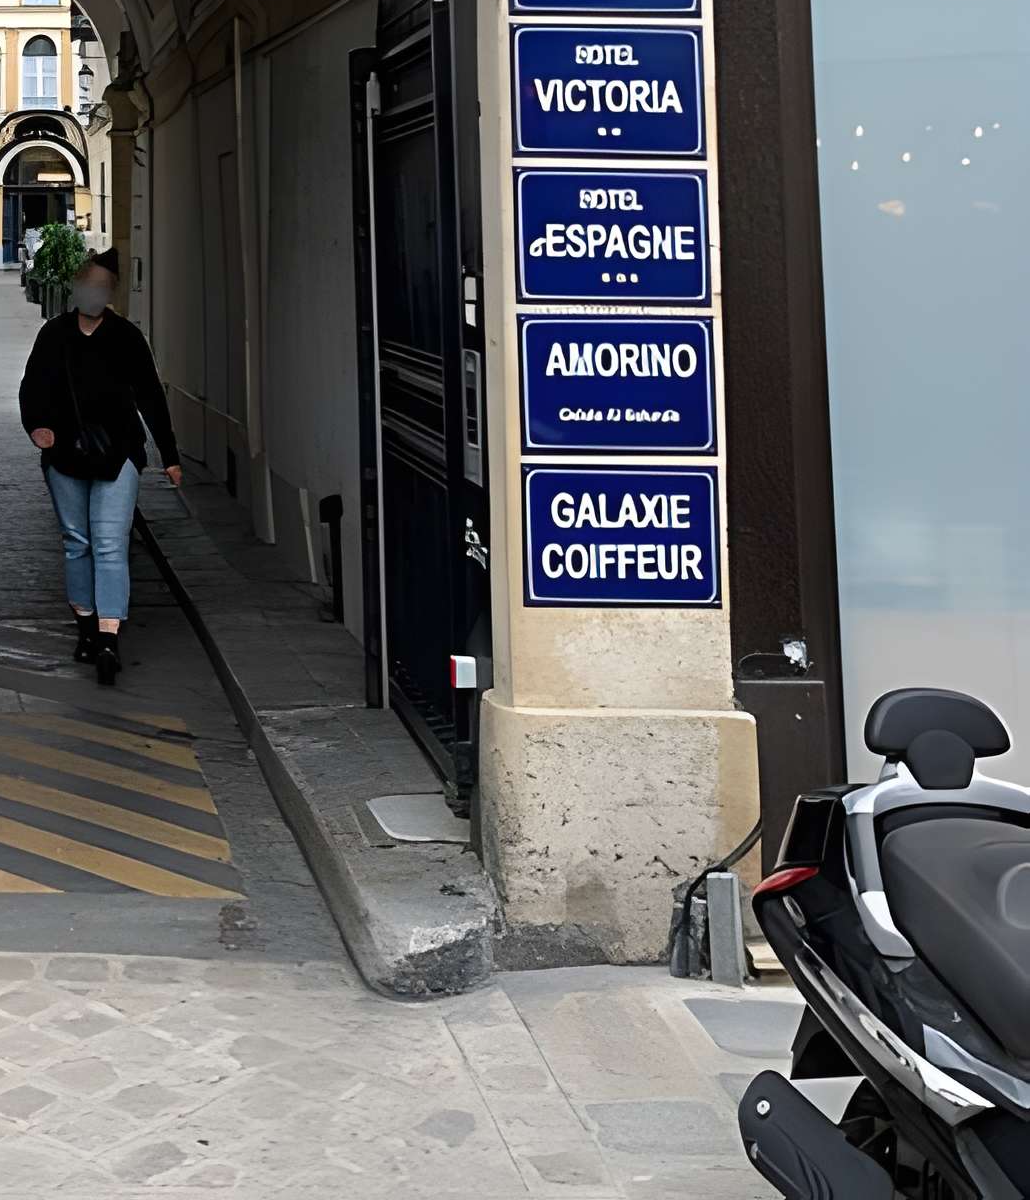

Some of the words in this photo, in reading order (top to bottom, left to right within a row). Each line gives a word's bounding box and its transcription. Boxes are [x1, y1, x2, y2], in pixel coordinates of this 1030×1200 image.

[533, 78, 684, 114] VICTORIA
[545, 342, 698, 378] AMORINO
[550, 492, 691, 529] GALAXIE
[541, 543, 704, 580] COIFFEUR
